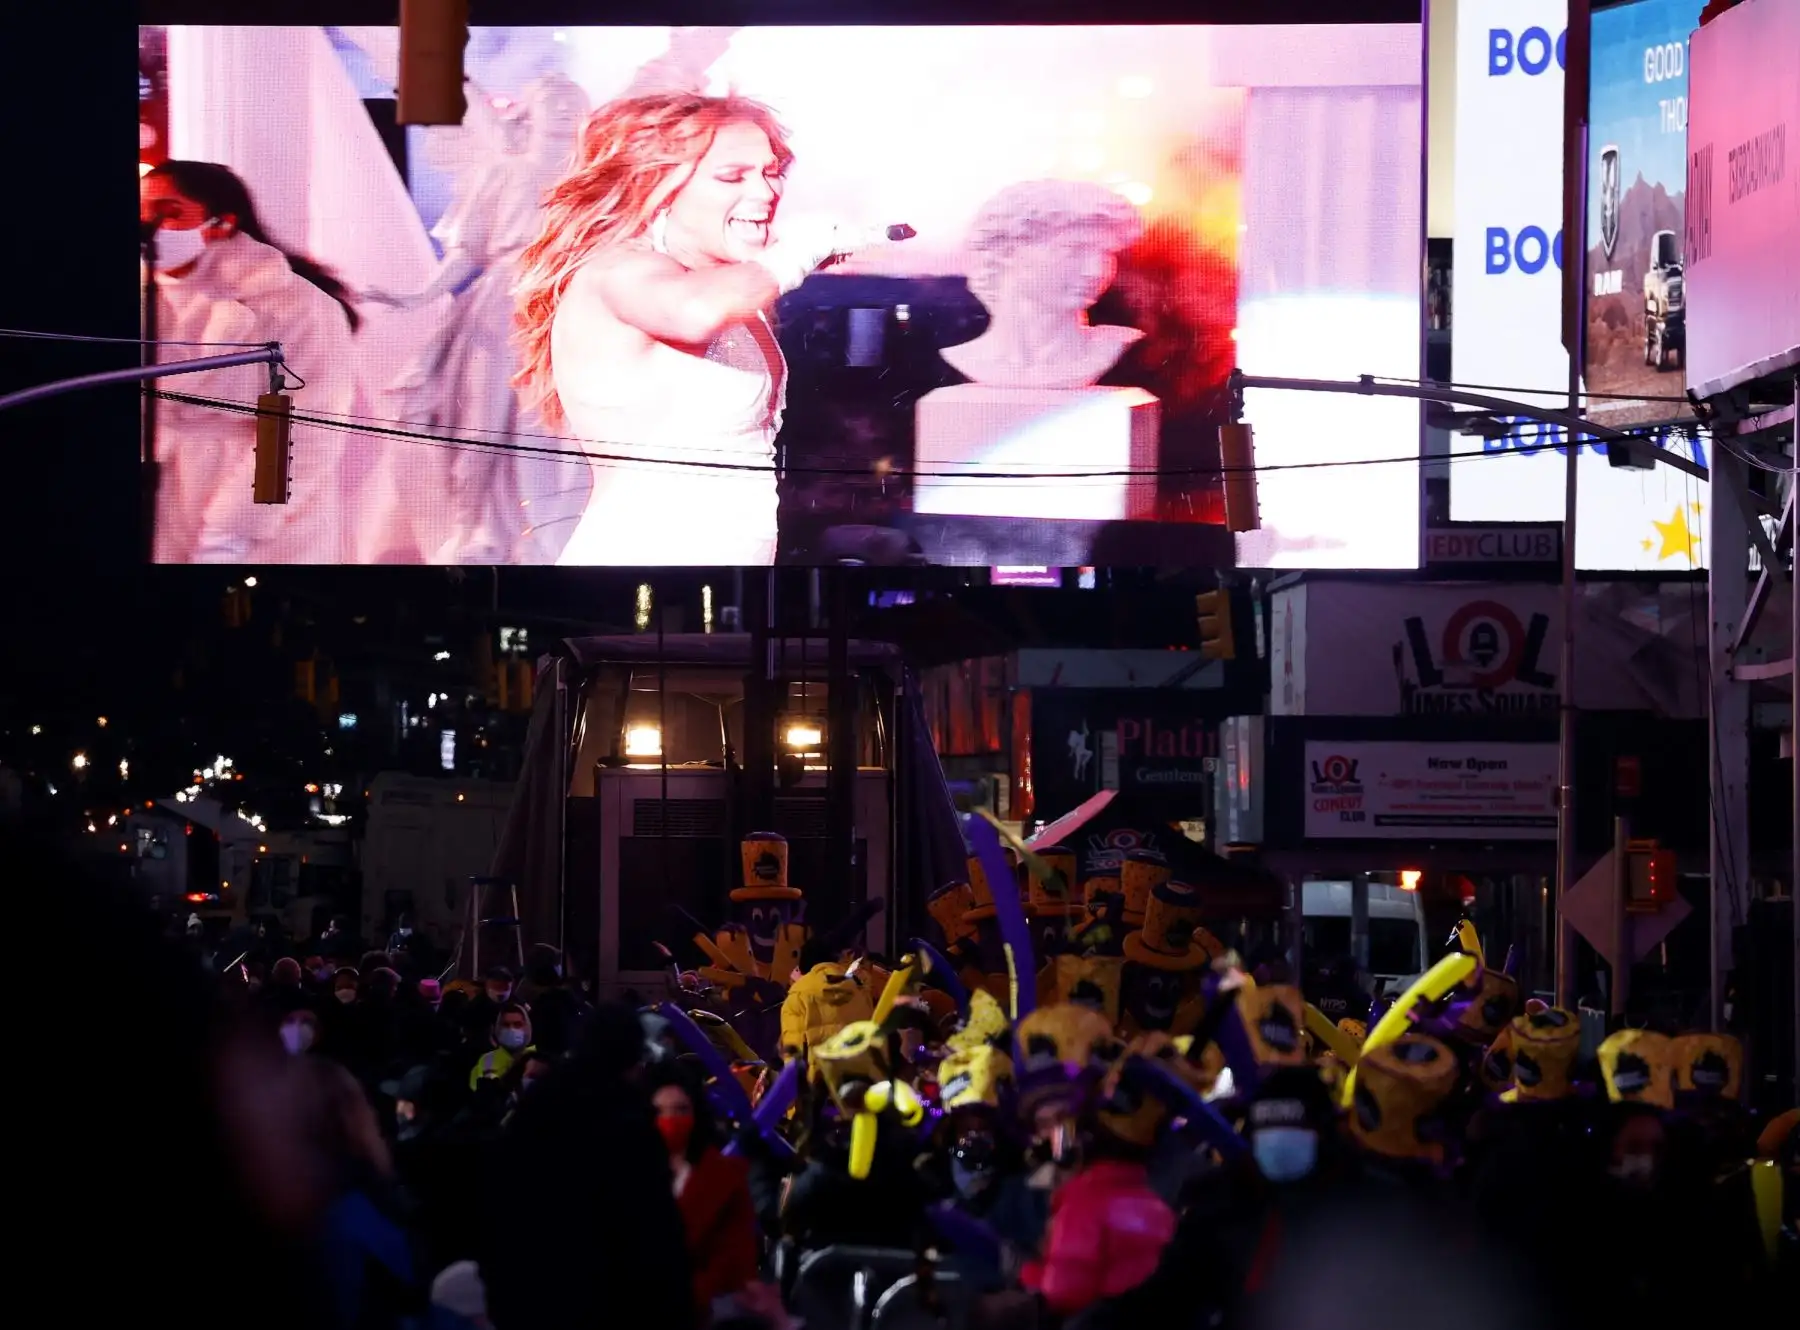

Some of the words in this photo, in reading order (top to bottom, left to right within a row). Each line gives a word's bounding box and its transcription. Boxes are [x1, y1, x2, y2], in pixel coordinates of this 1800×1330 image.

[1644, 42, 1684, 83] GOOD
[1659, 97, 1688, 133] THO
[1594, 270, 1622, 296] RAM
[1405, 600, 1556, 689] LOL
[1312, 755, 1361, 783] LOL
[1466, 757, 1508, 773] Open
